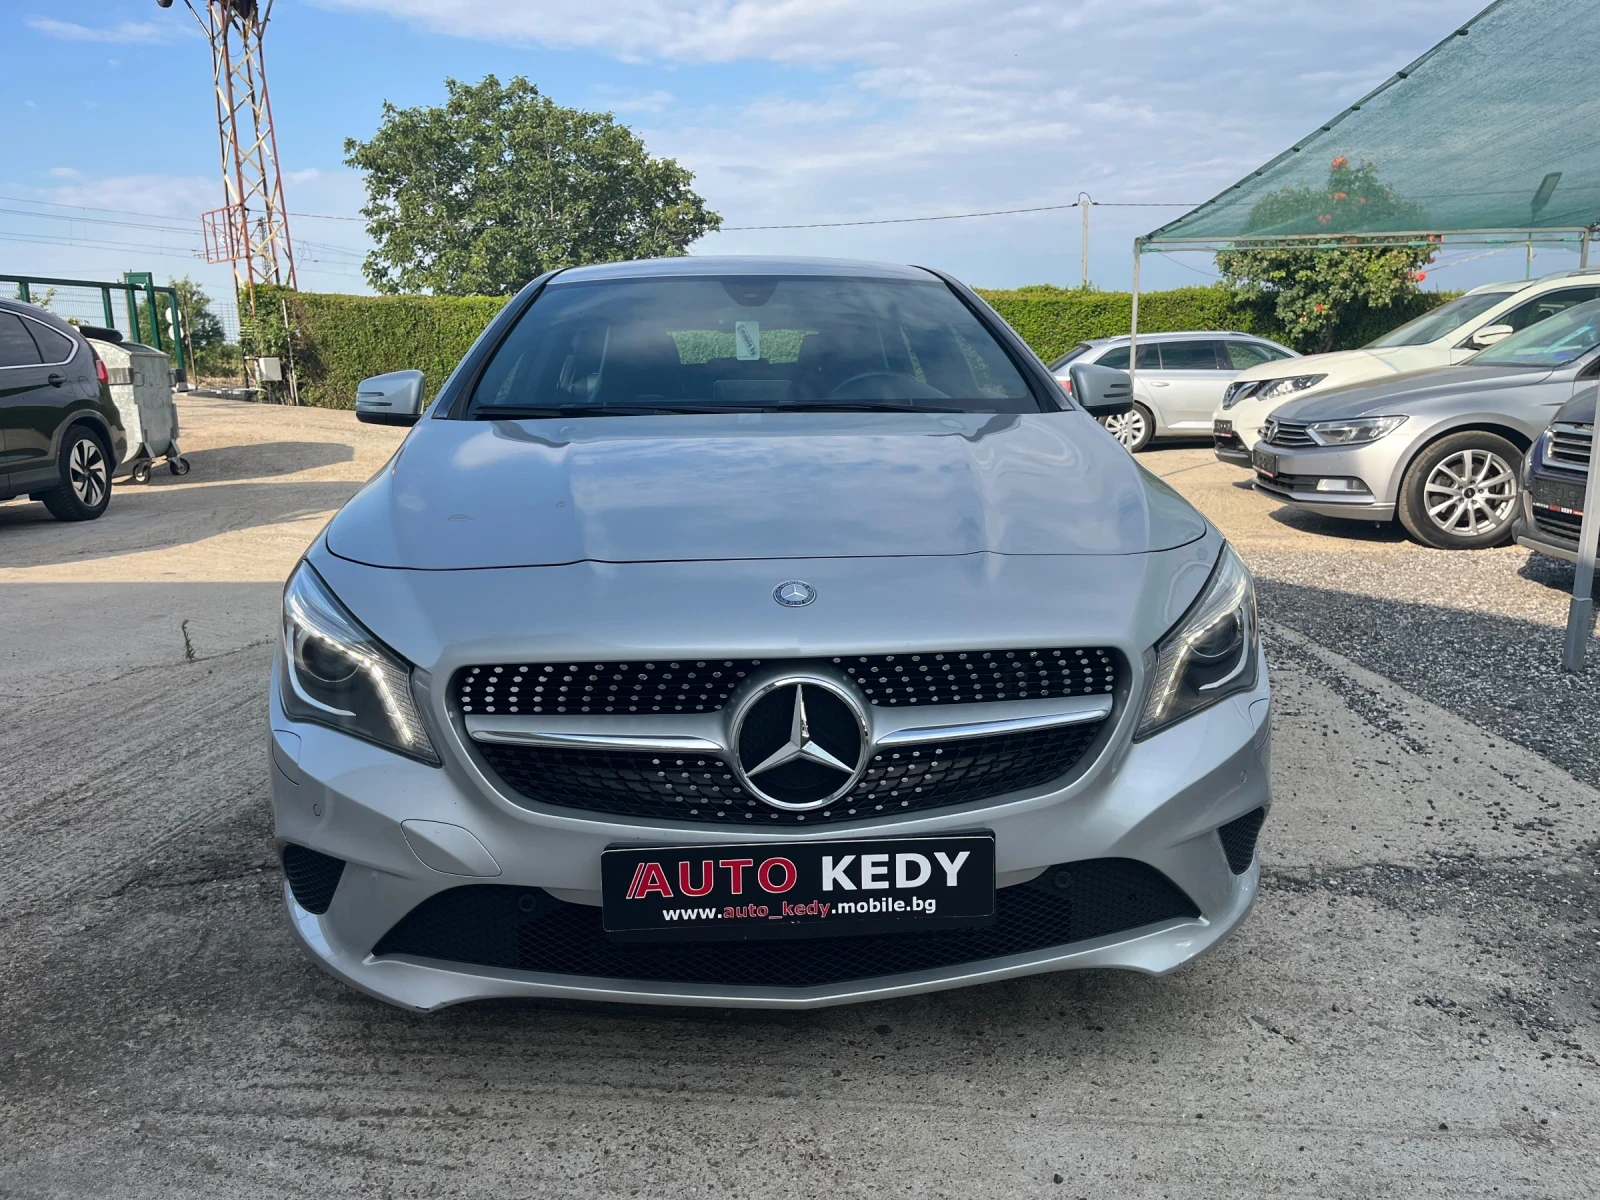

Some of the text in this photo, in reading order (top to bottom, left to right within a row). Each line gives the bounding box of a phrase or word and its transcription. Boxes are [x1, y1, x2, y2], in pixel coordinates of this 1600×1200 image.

[626, 851, 971, 899] AUTO KEDY
[663, 896, 937, 921] www.auto_kedy.mobile.bg
